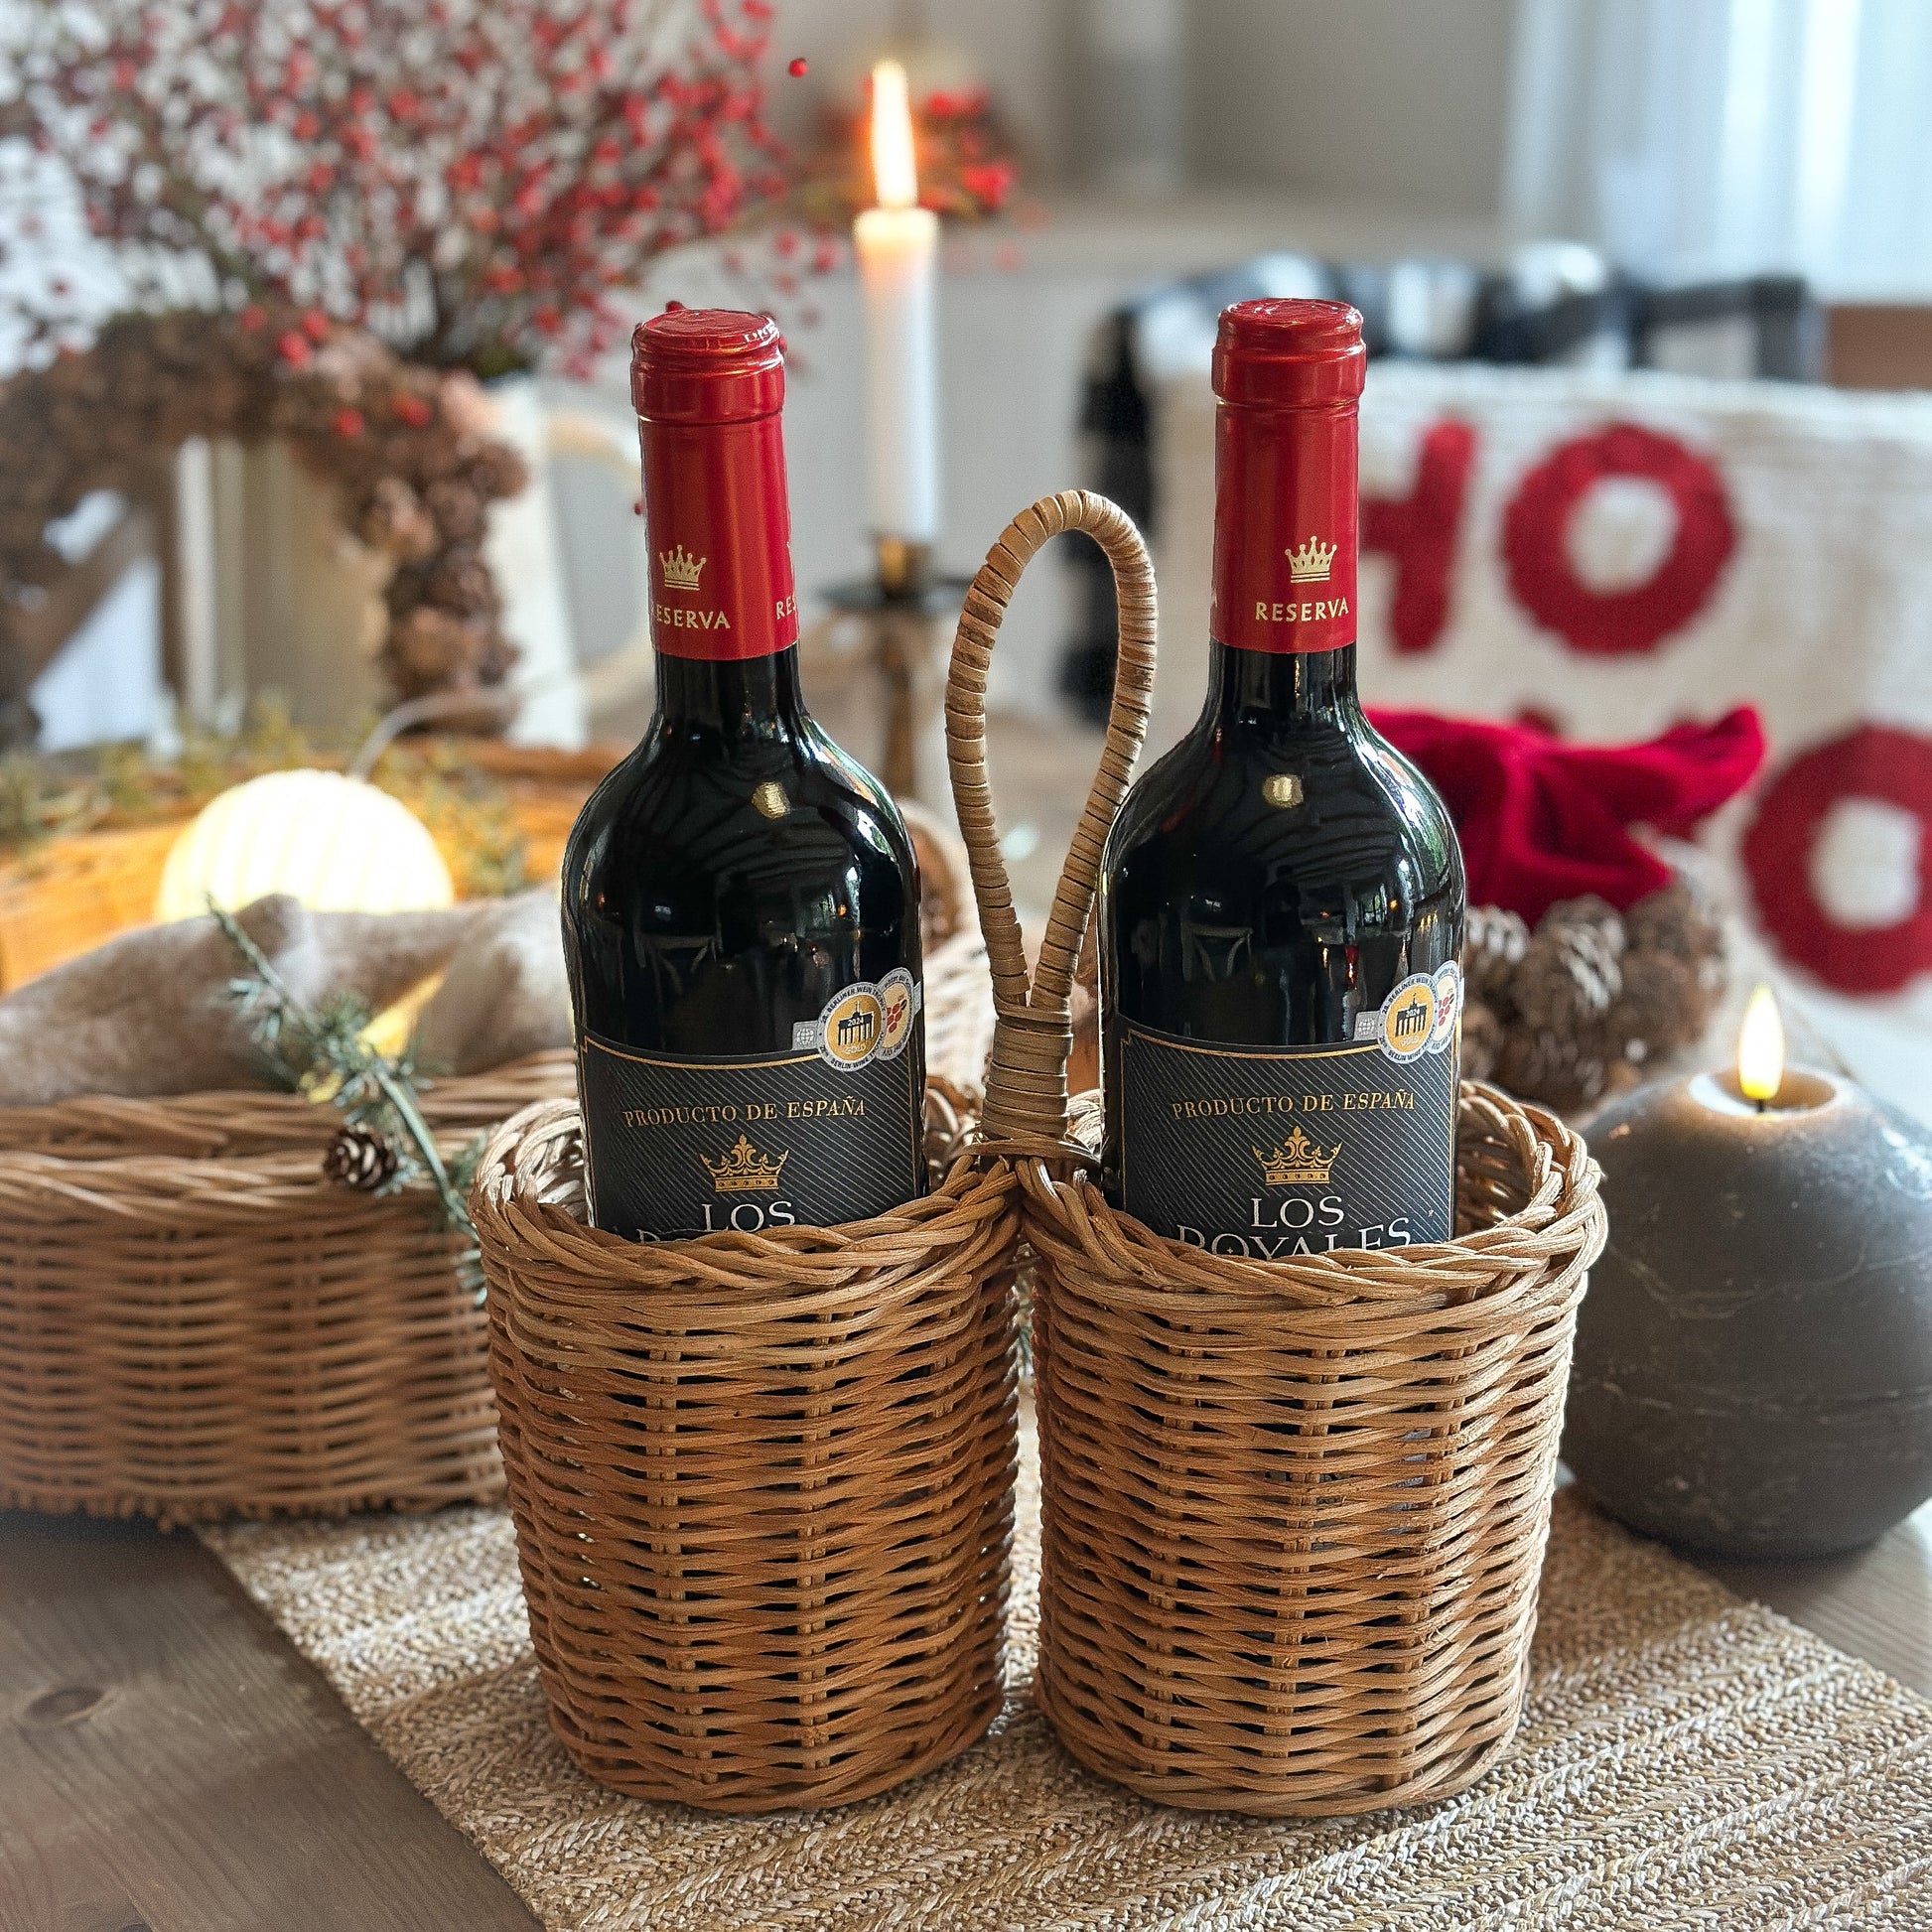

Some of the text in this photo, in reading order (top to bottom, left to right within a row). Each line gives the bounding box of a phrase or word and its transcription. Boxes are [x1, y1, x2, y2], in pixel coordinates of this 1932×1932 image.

[1255, 597, 1349, 622] RESERVA
[621, 1095, 866, 1128] PRODUCTO DE ESPAÑA
[1172, 1088, 1415, 1120] PRODUCTO DE ESPAÑA
[700, 1200, 795, 1233] LOS
[1250, 1195, 1345, 1229] LOS
